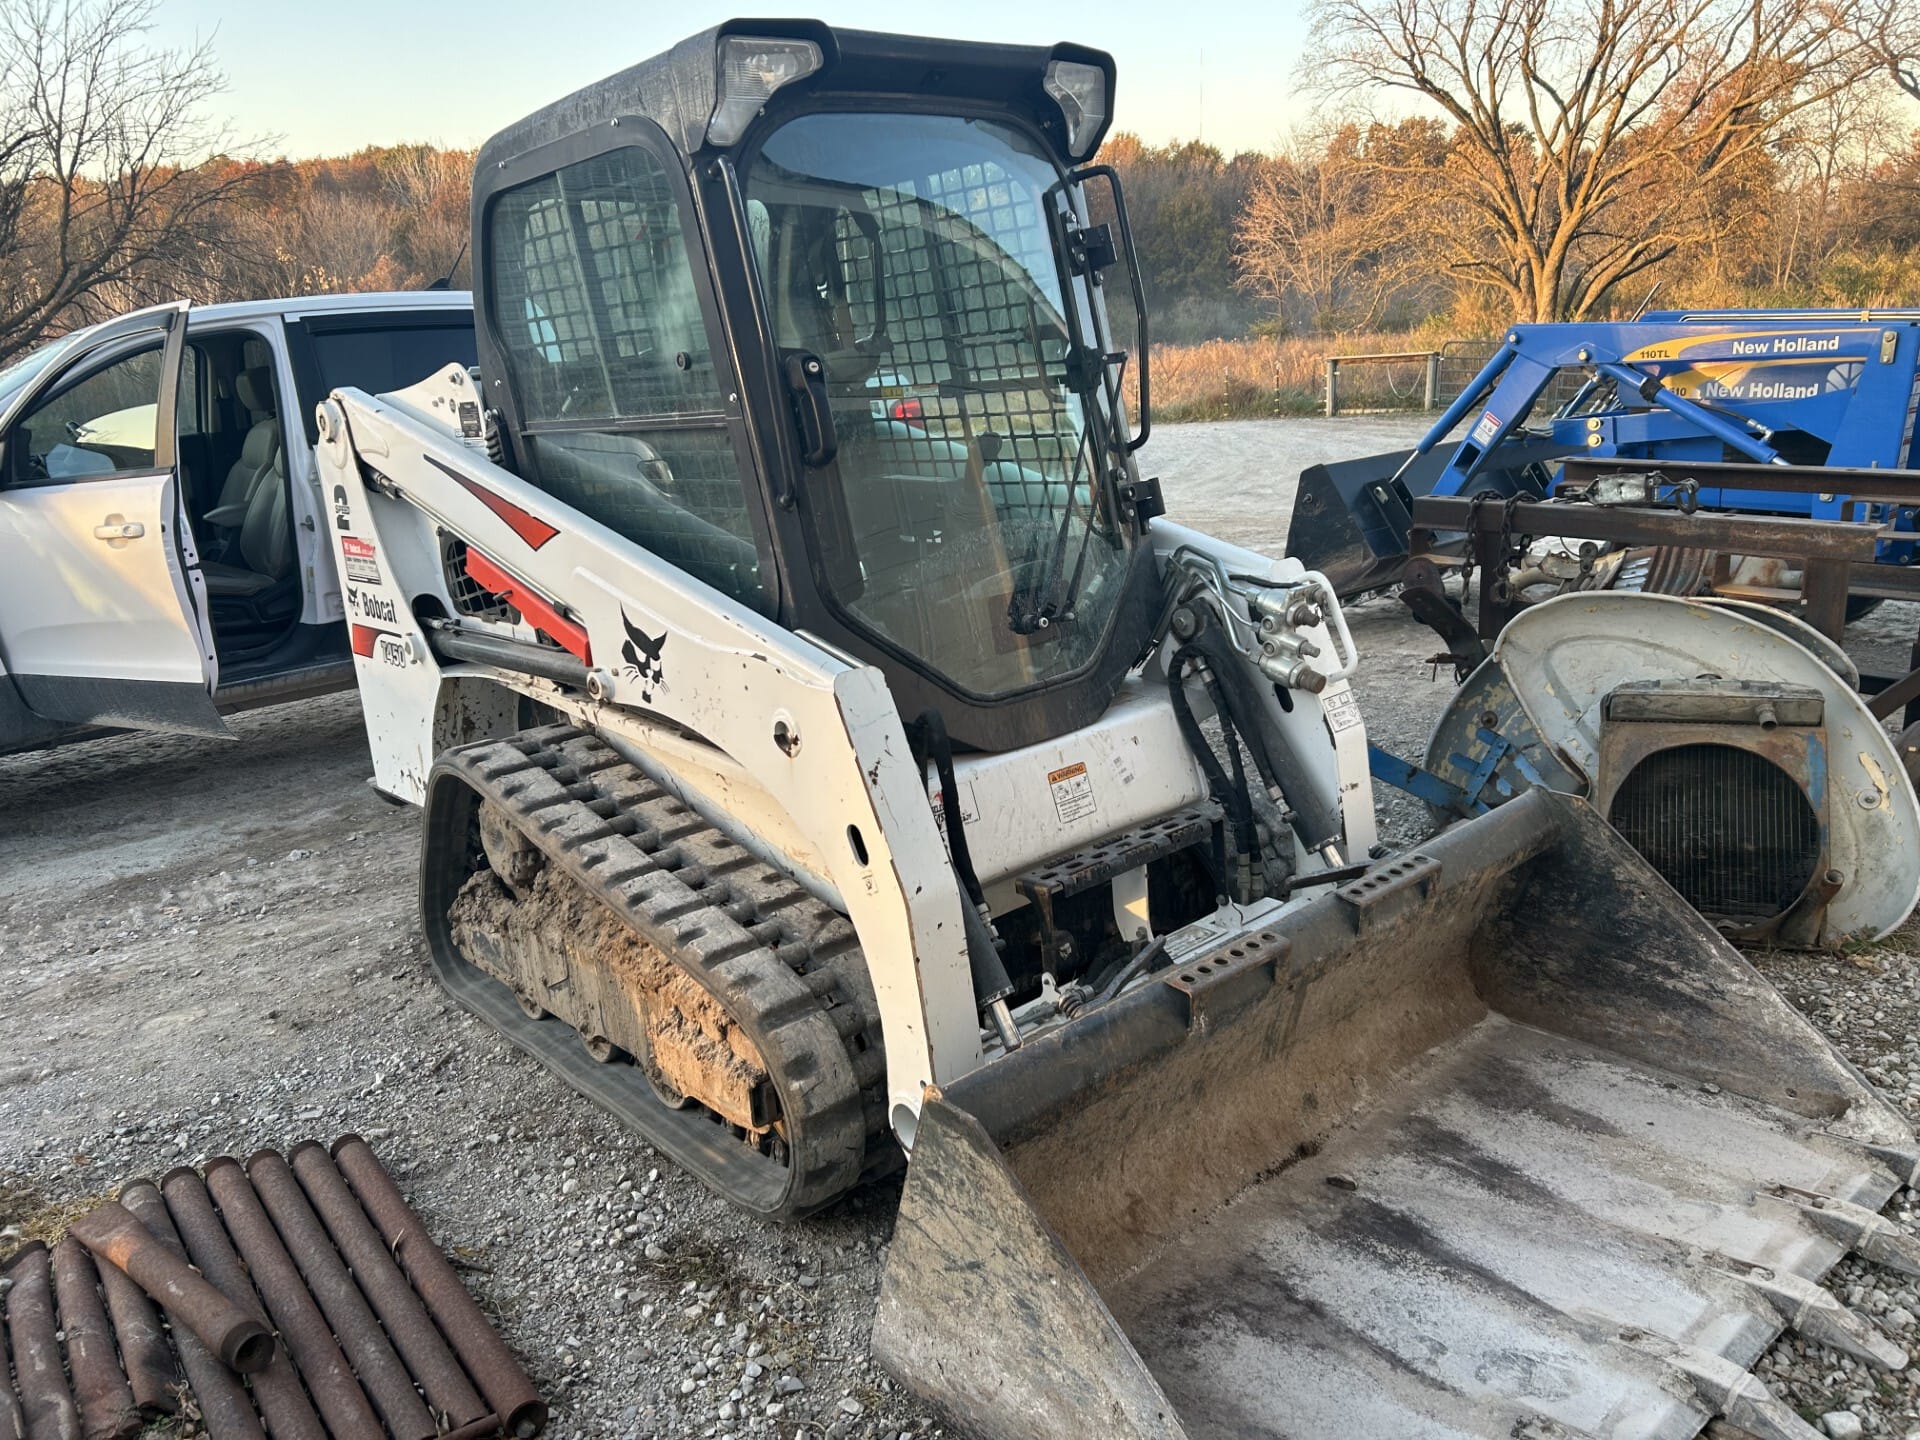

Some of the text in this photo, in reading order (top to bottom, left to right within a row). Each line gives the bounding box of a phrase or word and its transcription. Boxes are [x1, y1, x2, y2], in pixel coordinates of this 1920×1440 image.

[1732, 336, 1839, 354] New Holland
[1640, 350, 1670, 359] 110TL
[1705, 382, 1818, 399] New Holland
[362, 592, 397, 624] Bobcat
[380, 639, 406, 668] T450
[1058, 764, 1084, 779] WARNING
